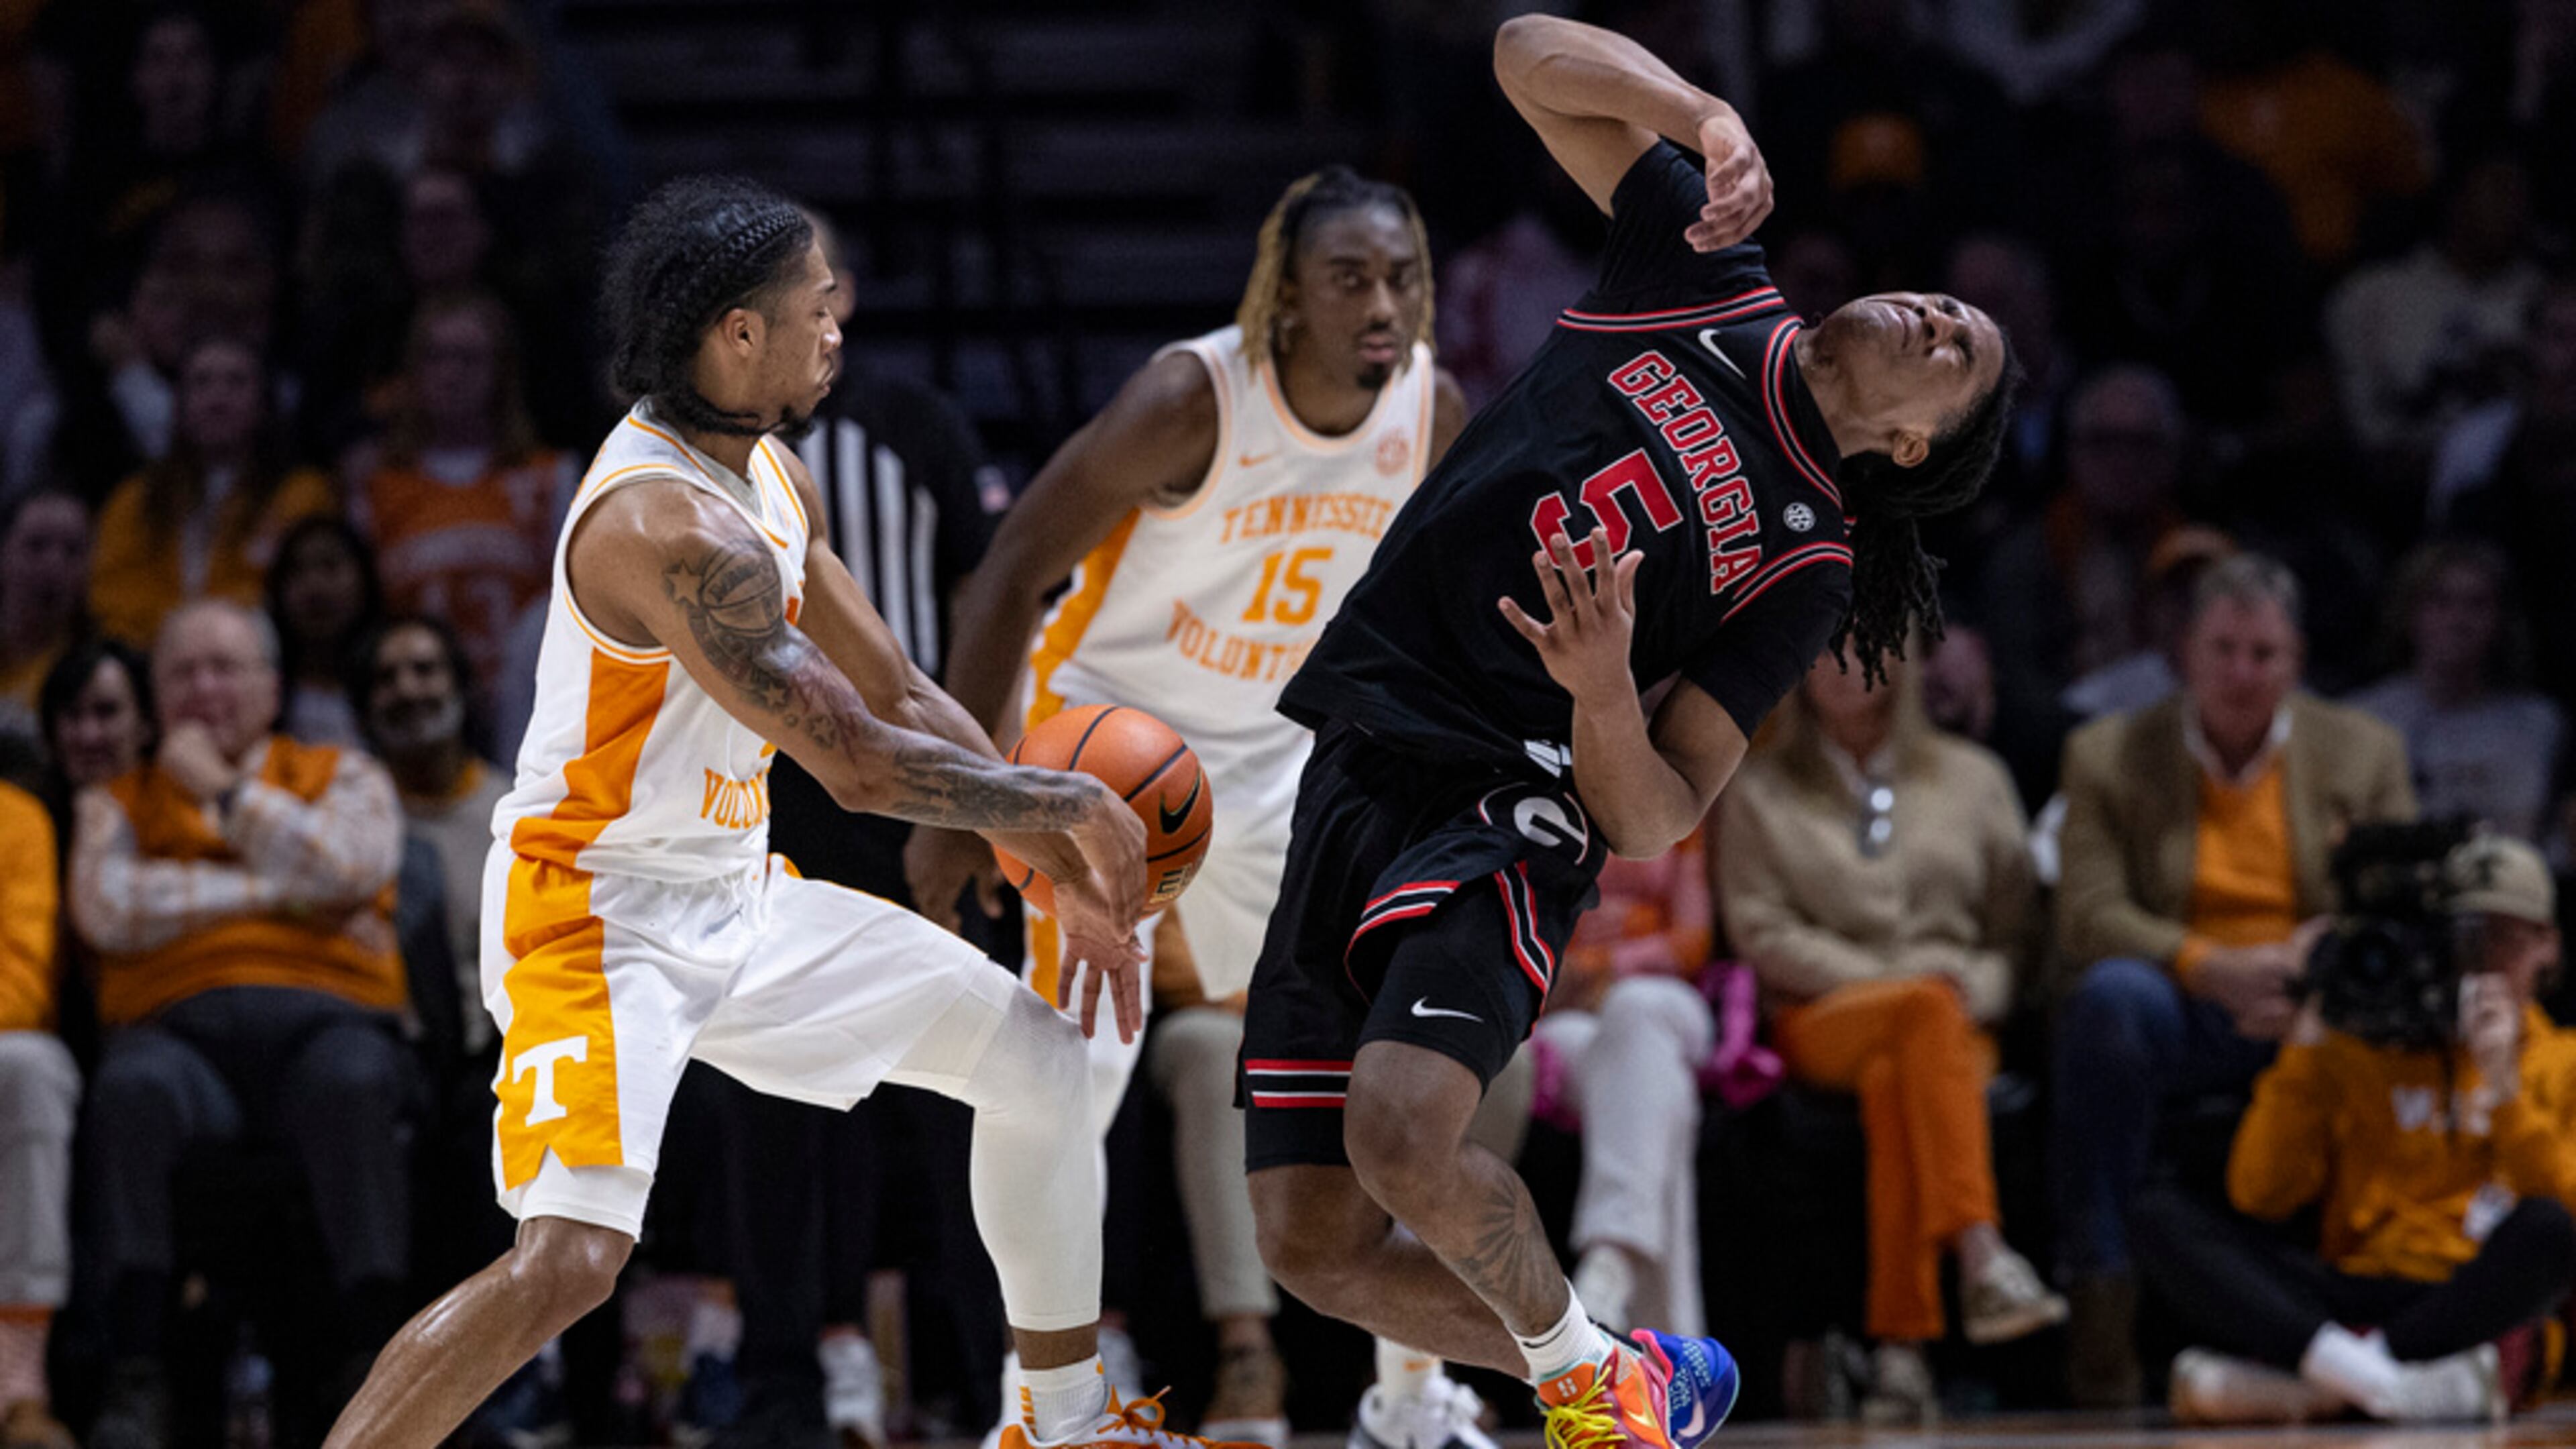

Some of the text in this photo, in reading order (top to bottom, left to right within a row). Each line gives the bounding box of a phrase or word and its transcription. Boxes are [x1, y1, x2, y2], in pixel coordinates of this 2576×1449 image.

[1530, 447, 1684, 572] 5
[1607, 350, 1762, 596] GEORGIA
[1242, 547, 1335, 626] 15
[513, 1035, 588, 1128] T
